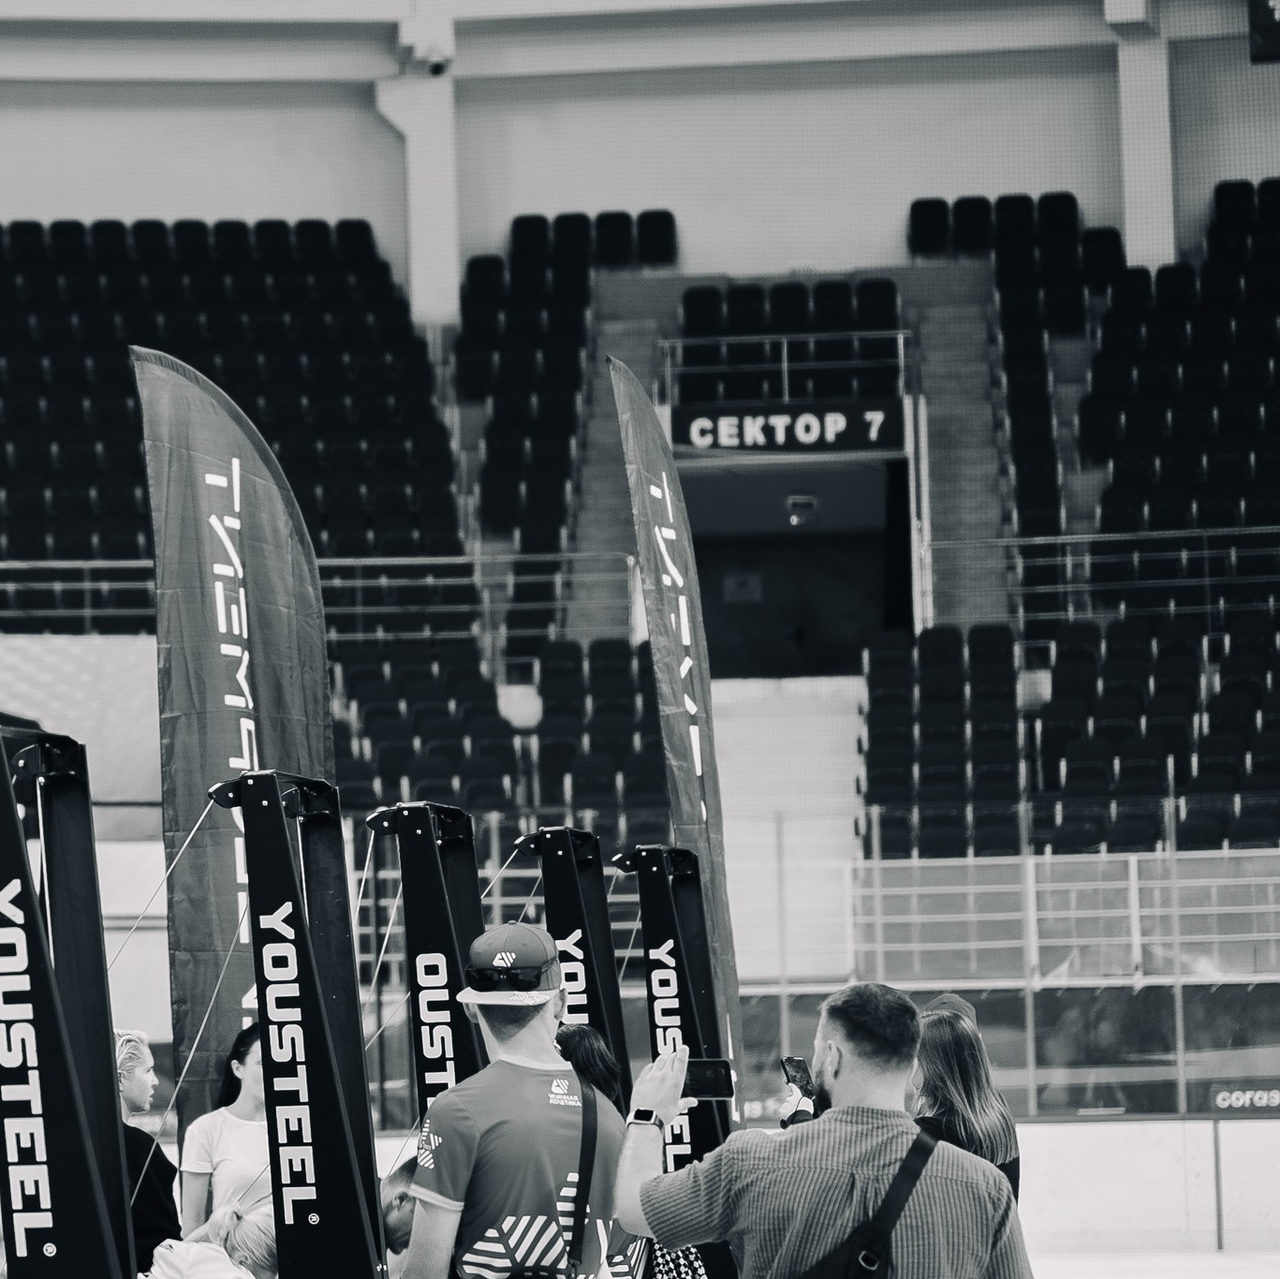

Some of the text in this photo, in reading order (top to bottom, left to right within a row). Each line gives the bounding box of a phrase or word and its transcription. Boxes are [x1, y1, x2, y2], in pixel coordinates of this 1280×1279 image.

[689, 410, 885, 449] СЕКТОР 7
[259, 901, 317, 1225] YOUSTEEL
[649, 939, 691, 1172] YOUSEL
